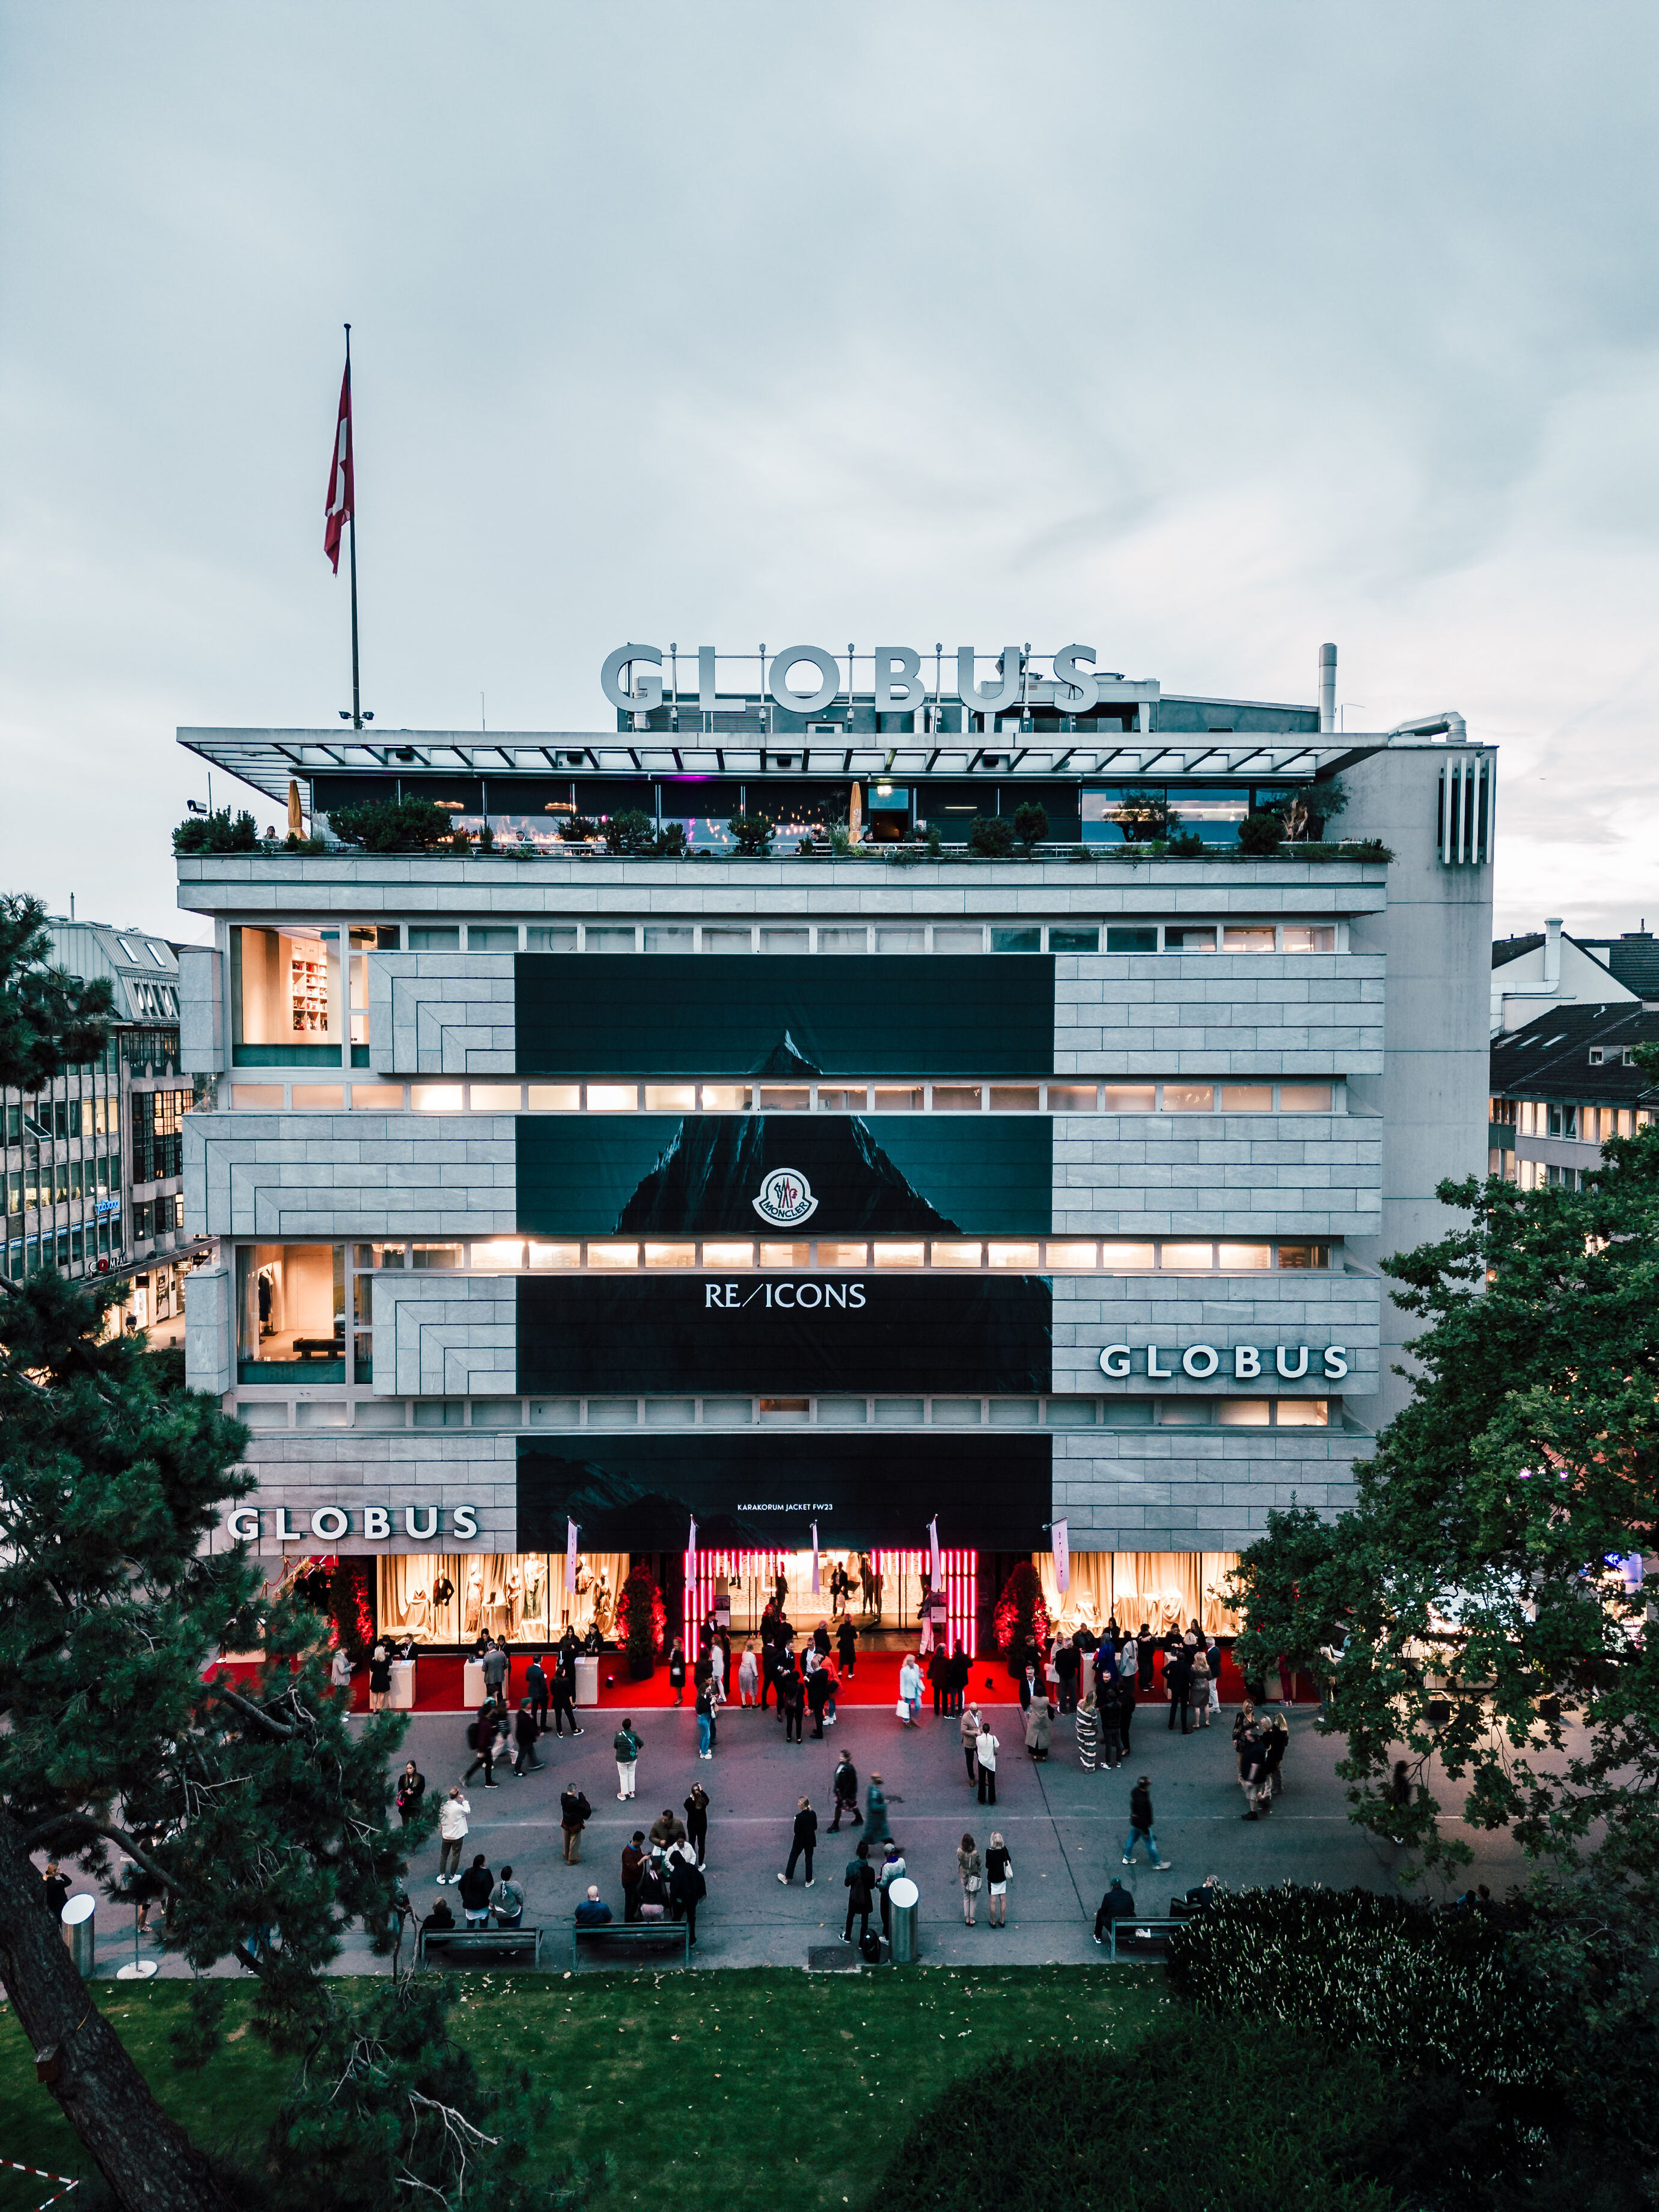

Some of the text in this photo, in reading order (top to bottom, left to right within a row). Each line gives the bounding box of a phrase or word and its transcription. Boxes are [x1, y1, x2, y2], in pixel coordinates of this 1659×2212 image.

[601, 644, 1100, 713] GLOBUS
[763, 1201, 807, 1218] MONCLER
[705, 1283, 866, 1308] RE/ICONS
[1099, 1344, 1348, 1379] GLOBUS
[227, 1505, 478, 1540] GLOBUS
